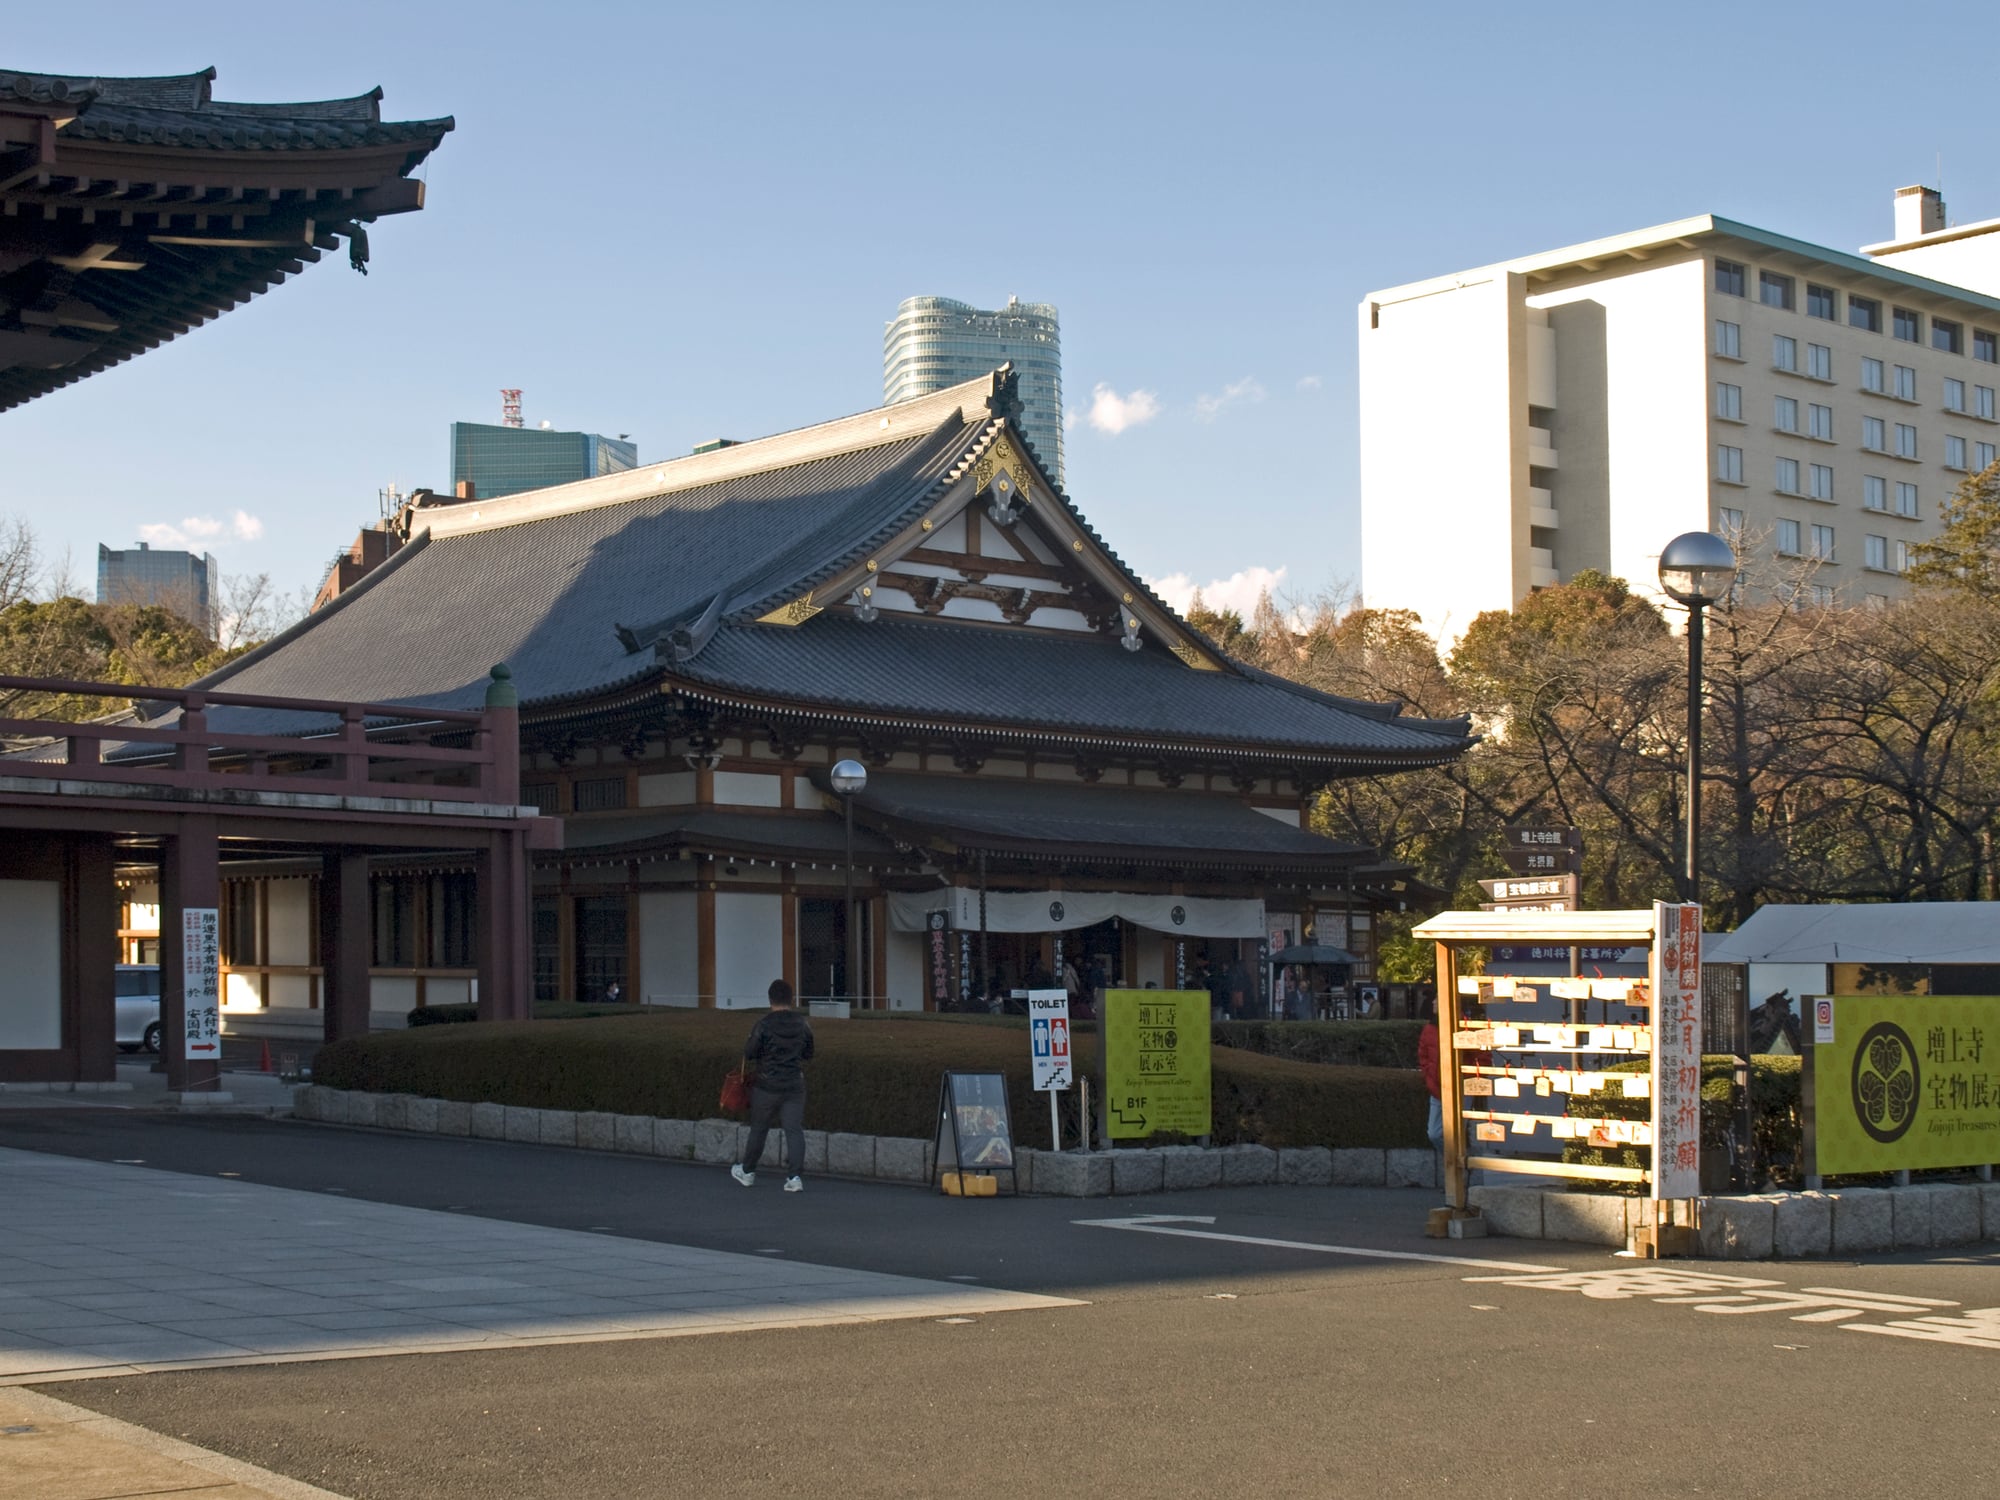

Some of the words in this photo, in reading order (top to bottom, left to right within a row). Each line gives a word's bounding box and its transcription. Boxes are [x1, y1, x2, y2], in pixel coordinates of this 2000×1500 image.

[1521, 831, 1562, 844] 増上寺会館
[1508, 881, 1561, 896] 宝物展示室
[1031, 999, 1066, 1010] TOILET
[186, 1008, 201, 1040] 安国殿
[203, 1006, 218, 1039] 受付中
[1138, 1007, 1177, 1026] 増上寺
[1926, 1025, 1984, 1064] 増上寺
[1138, 1053, 1177, 1072] 展示室
[1674, 993, 1698, 1173] 正月初祈願
[1127, 1097, 1147, 1109] B1F
[1927, 1118, 1954, 1136] Zojoji
[1956, 1117, 1997, 1132] Treasures
